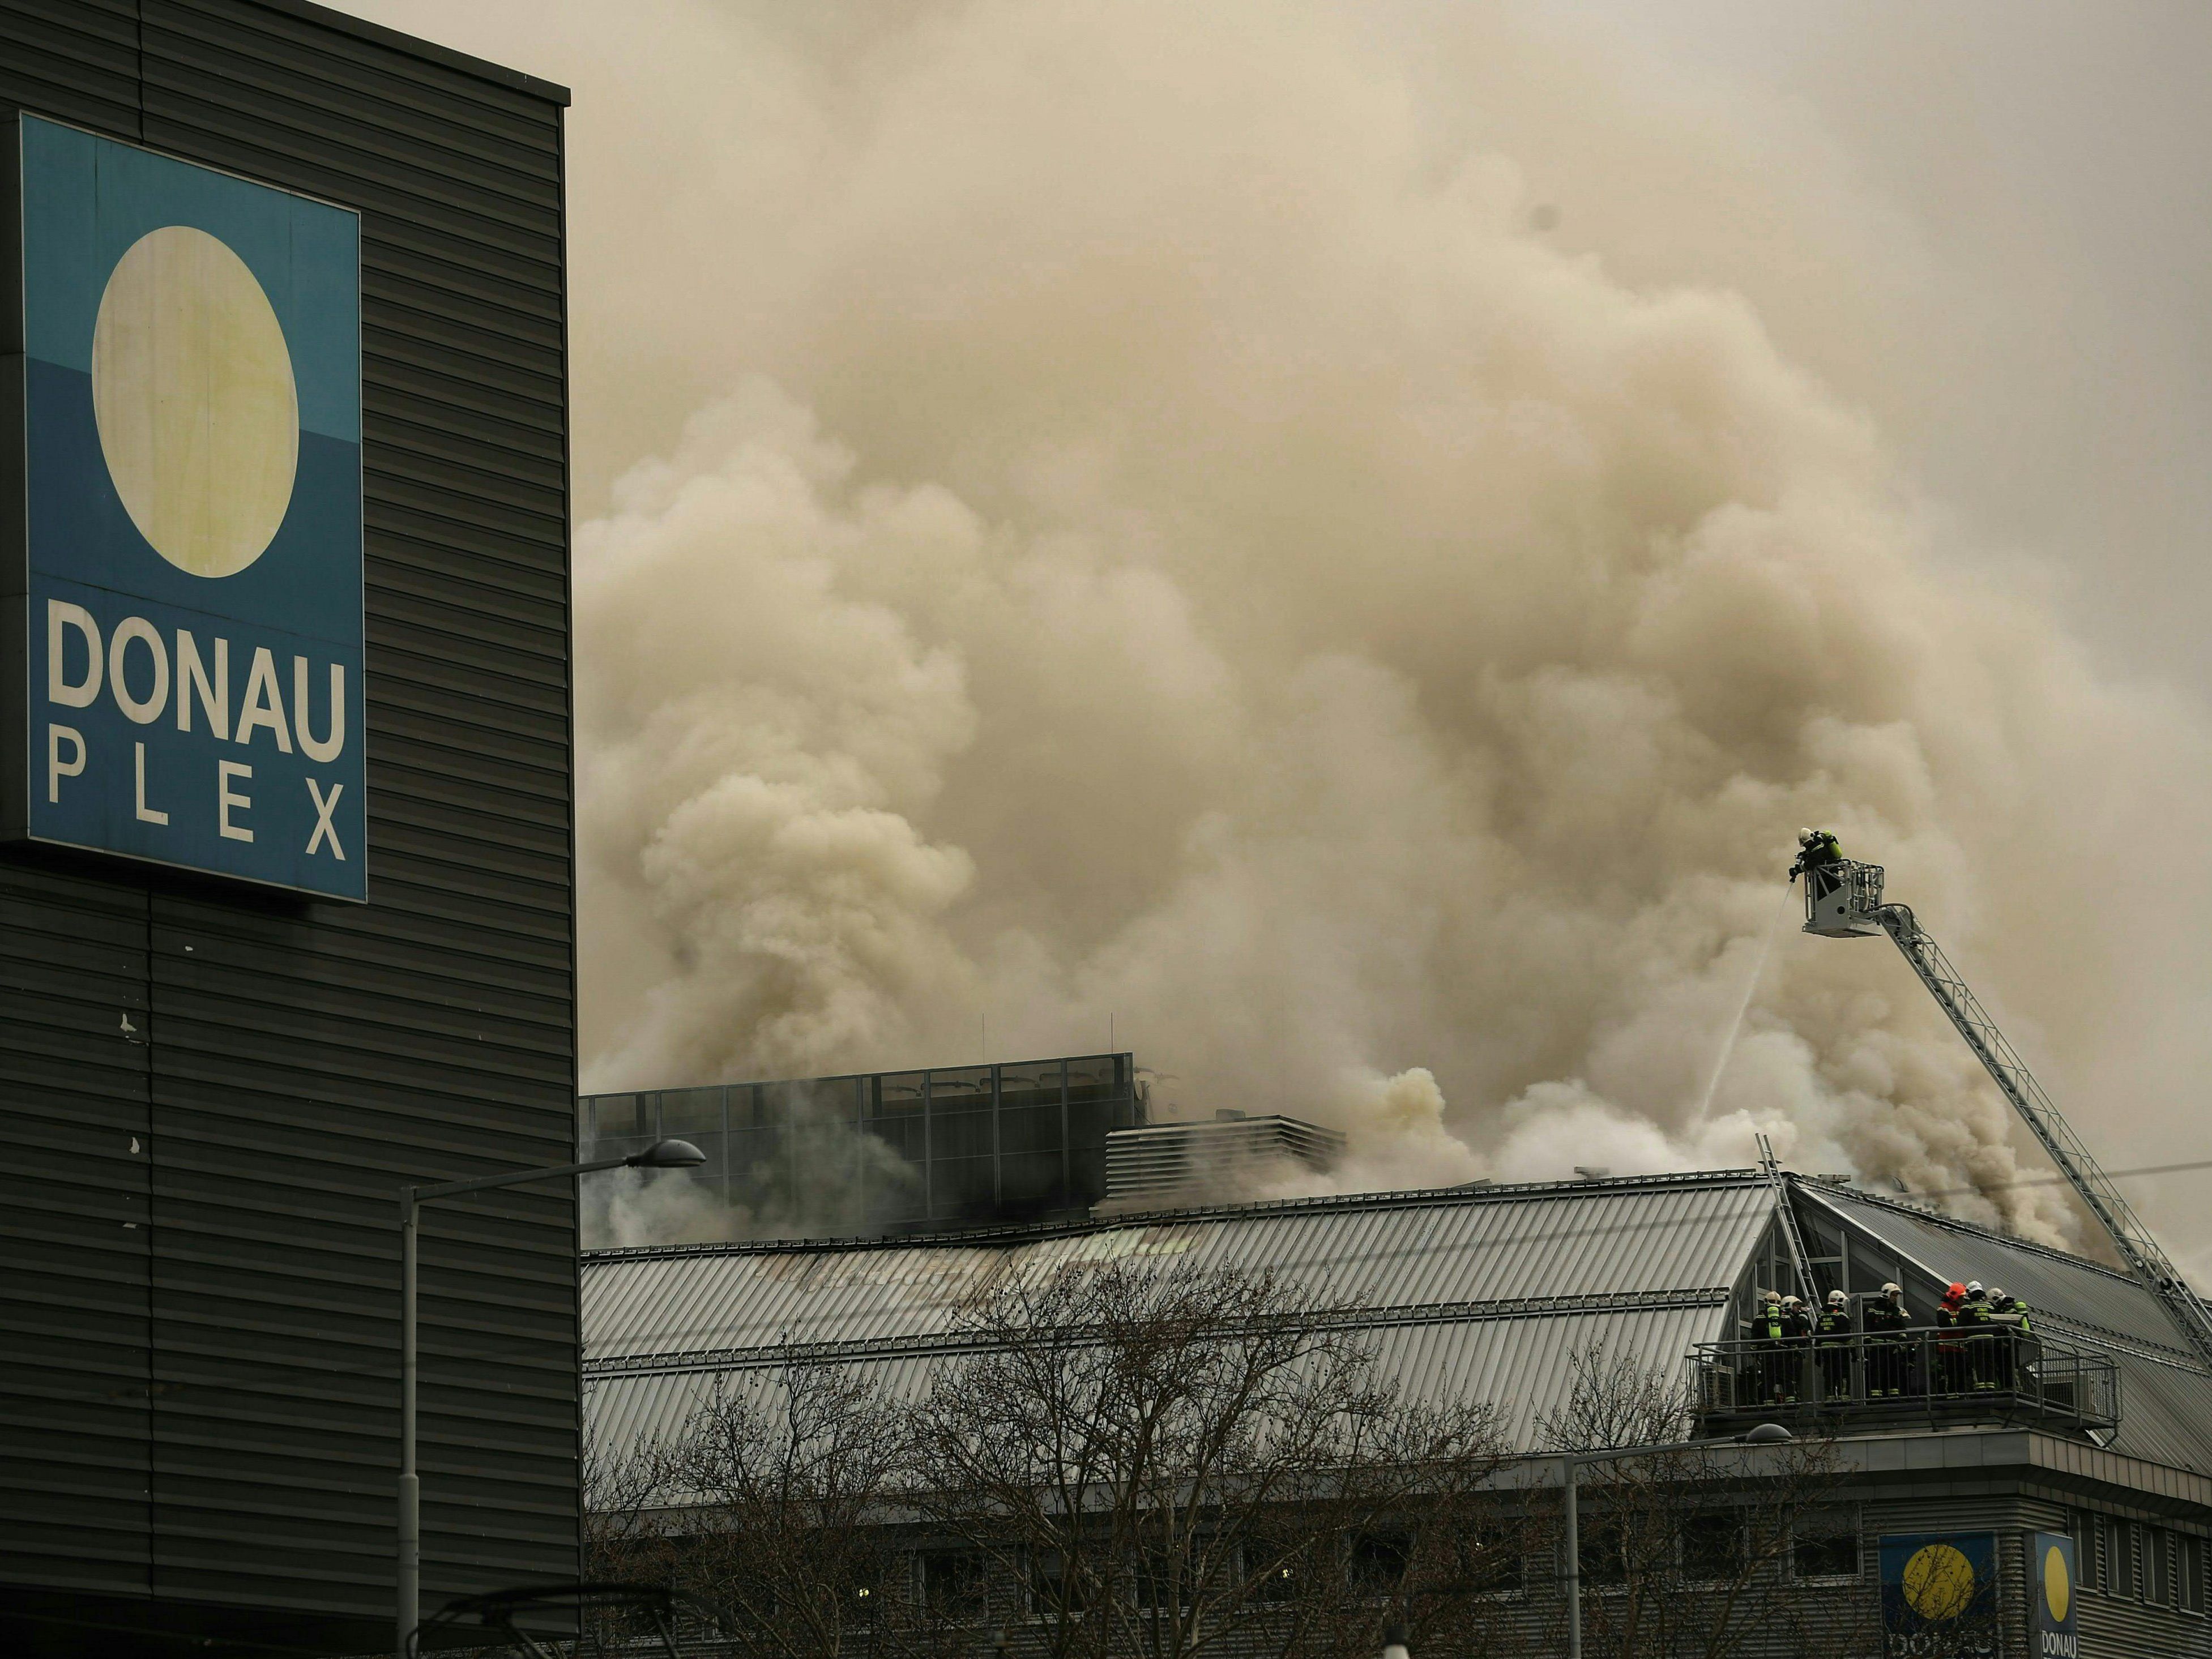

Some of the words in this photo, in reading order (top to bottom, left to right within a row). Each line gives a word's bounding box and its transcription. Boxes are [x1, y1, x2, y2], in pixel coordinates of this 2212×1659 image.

[49, 598, 344, 763] DONAU
[49, 723, 345, 861] PLEX
[2042, 1630, 2077, 1659] DONAU
